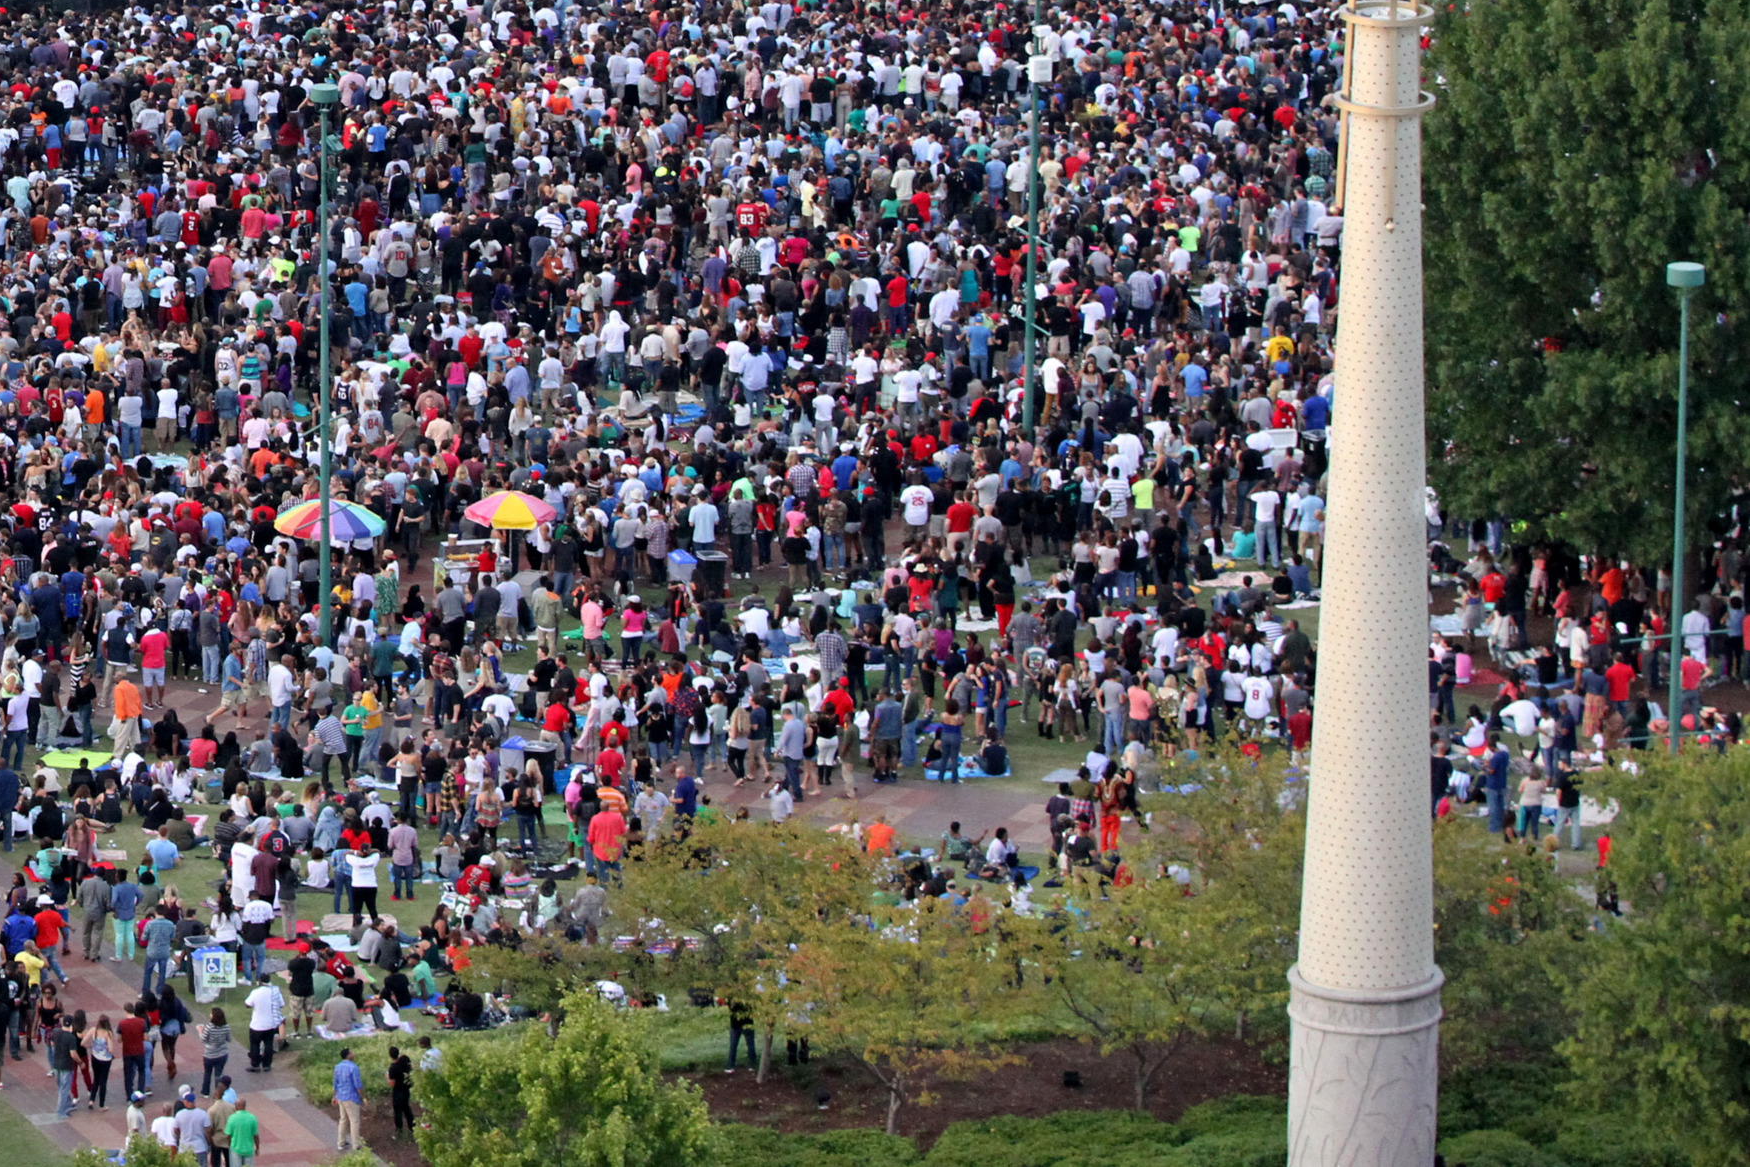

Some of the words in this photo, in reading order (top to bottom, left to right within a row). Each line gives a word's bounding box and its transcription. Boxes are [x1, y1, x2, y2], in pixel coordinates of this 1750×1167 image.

[740, 214, 754, 225] 83
[911, 496, 924, 507] 25
[272, 838, 284, 852] 3
